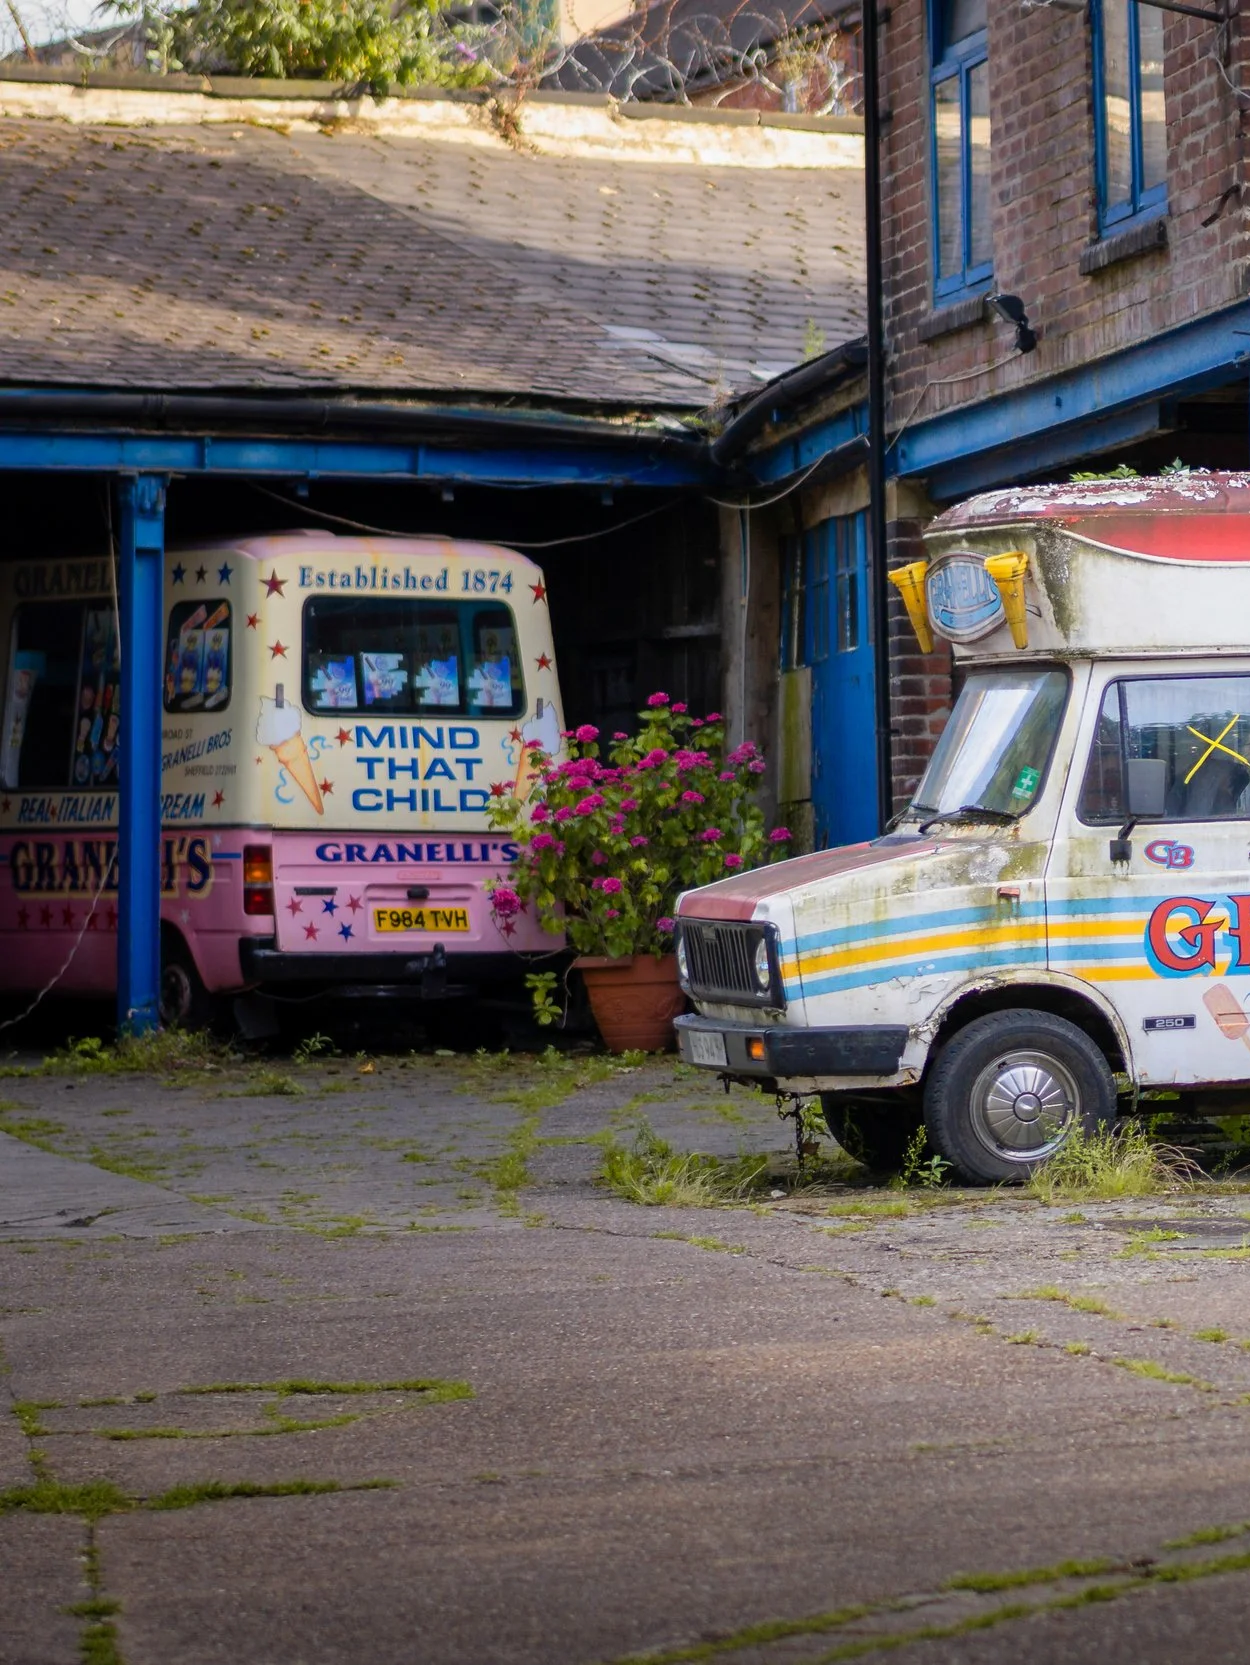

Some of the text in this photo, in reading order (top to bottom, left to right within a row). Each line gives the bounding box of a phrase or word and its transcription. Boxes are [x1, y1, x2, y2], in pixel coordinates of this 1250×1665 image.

[14, 562, 114, 597] GRANEL
[299, 565, 514, 594] Established 1874
[206, 727, 233, 755] BROS
[355, 725, 480, 749] MIND
[356, 756, 483, 781] THAT
[18, 793, 206, 823] REAL ITALIAN REAM
[352, 788, 491, 812] CHILD
[316, 842, 519, 863] GRANELLI'S
[11, 836, 211, 895] GRANEI'S
[376, 909, 468, 929] F984 TVH
[1155, 1018, 1185, 1028] 250
